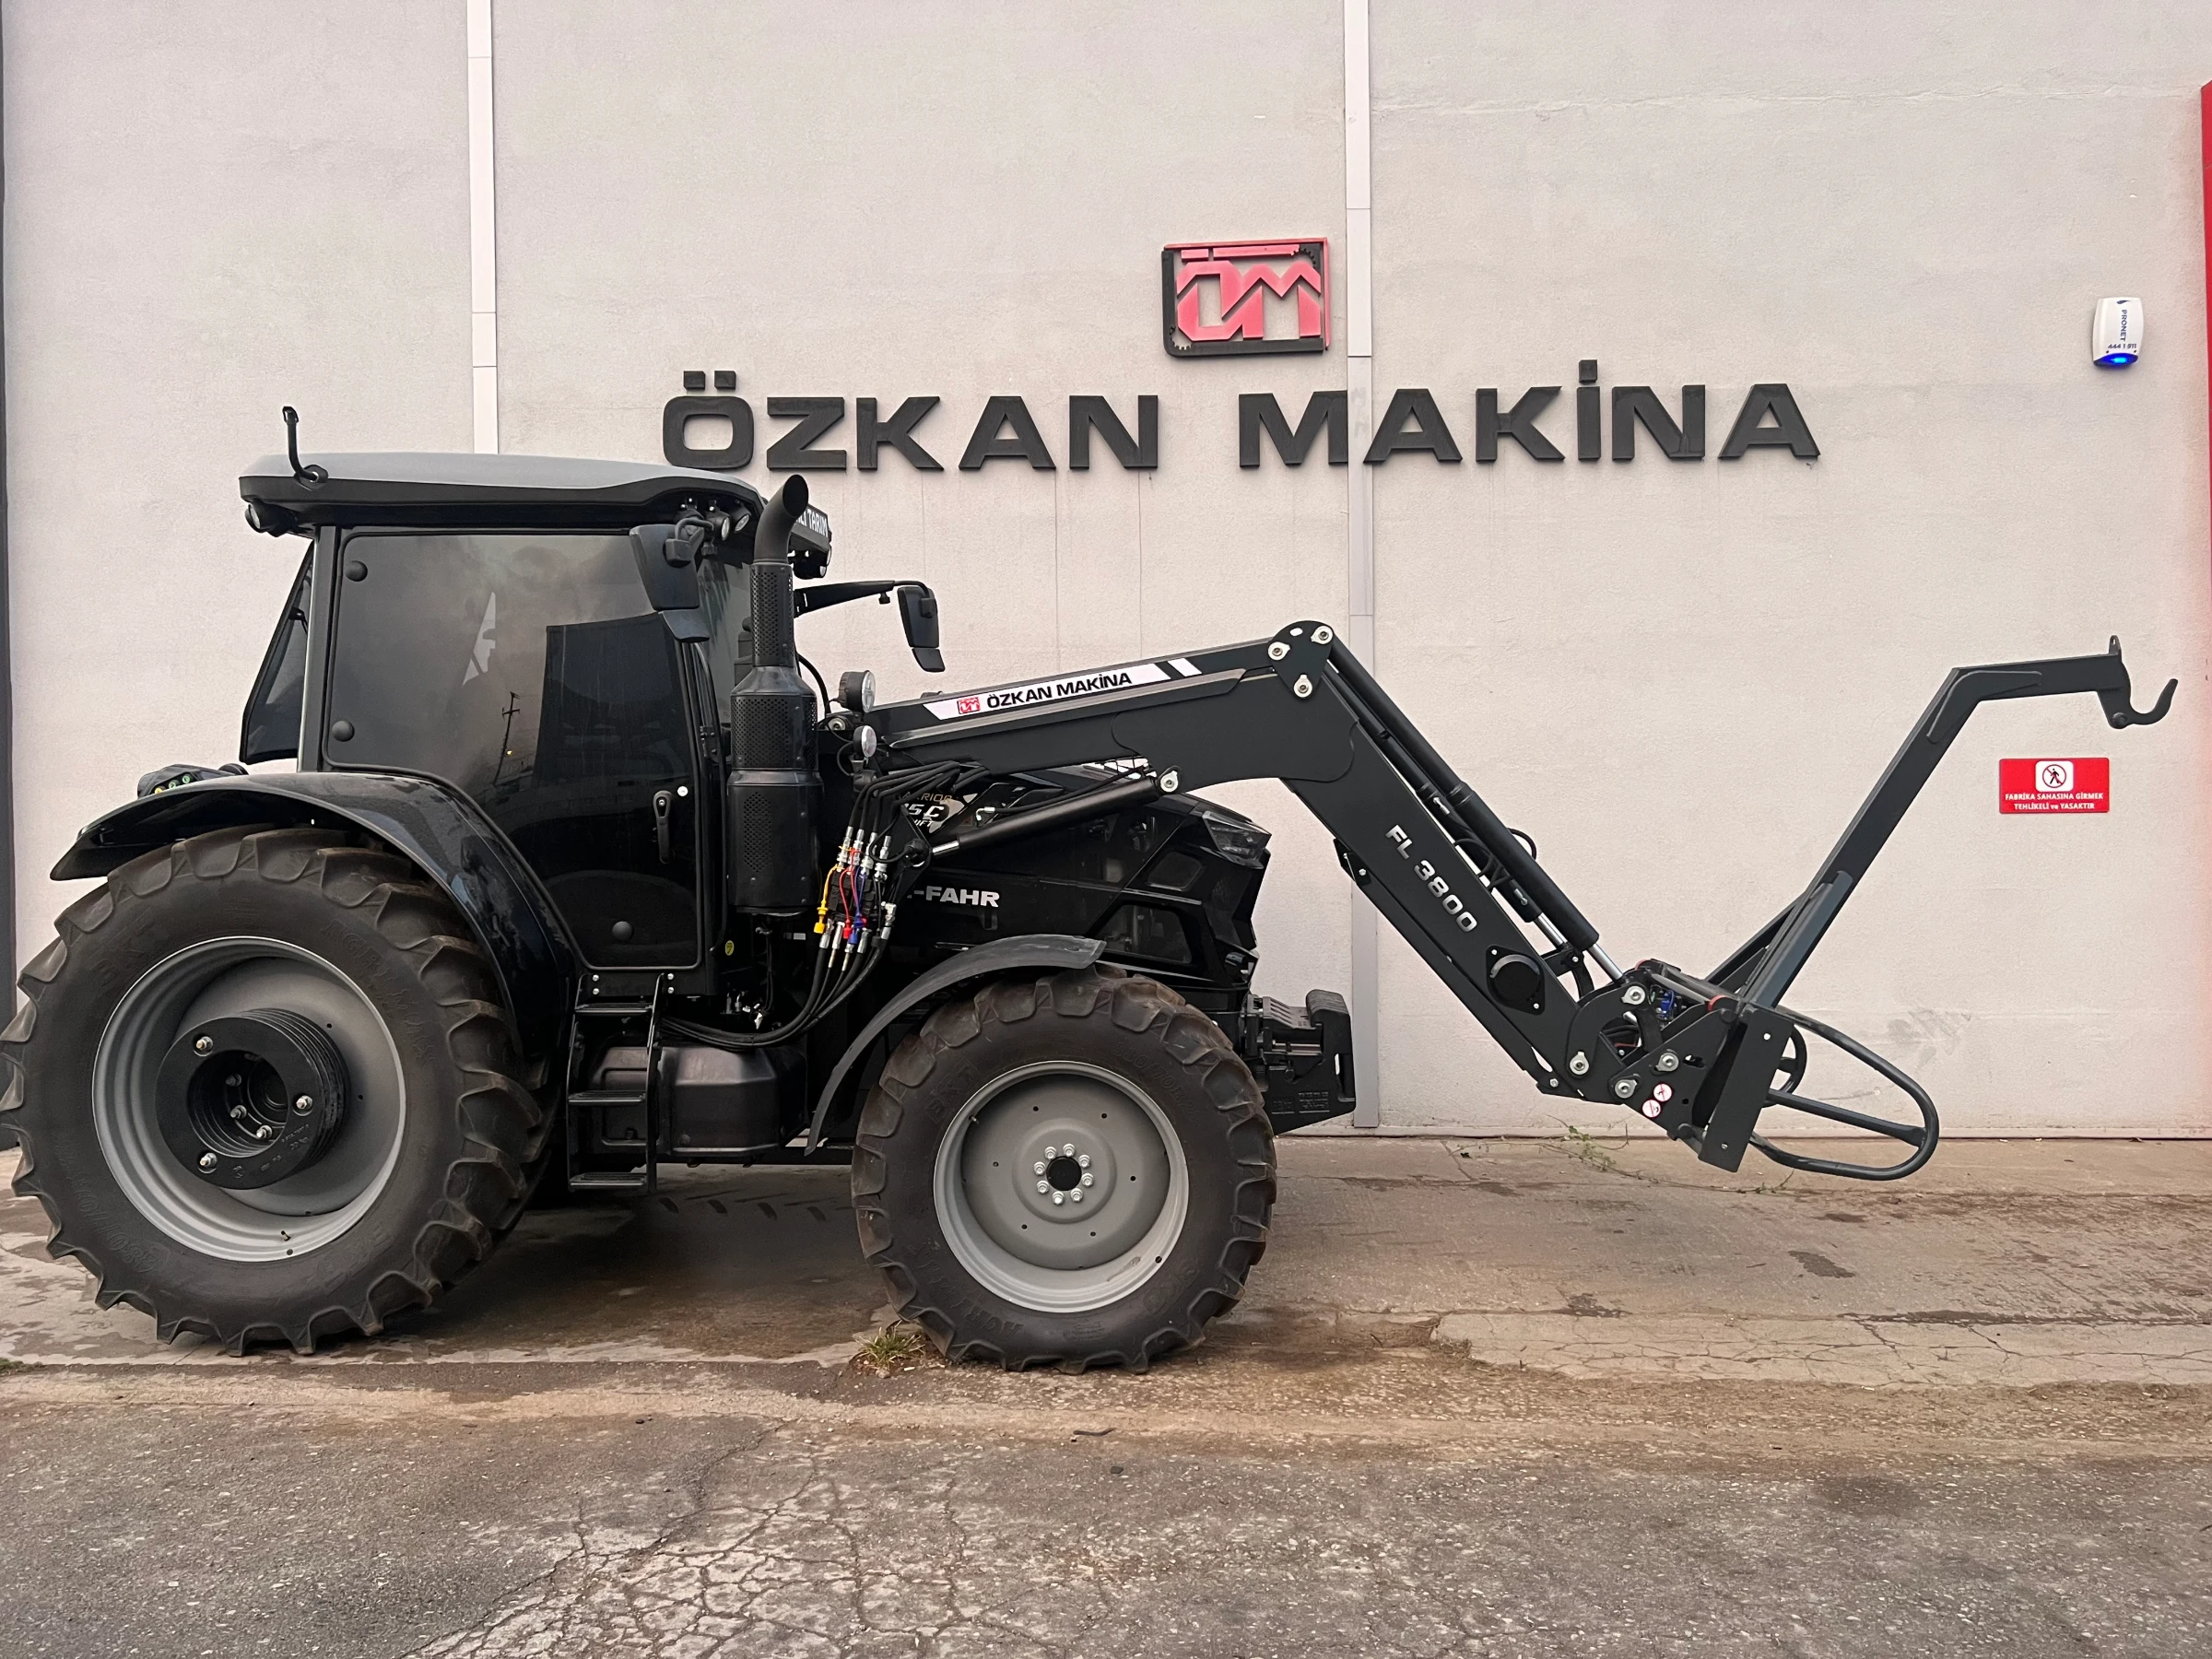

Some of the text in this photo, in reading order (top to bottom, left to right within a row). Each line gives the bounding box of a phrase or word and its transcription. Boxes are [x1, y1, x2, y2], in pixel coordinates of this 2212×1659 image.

[2120, 309, 2128, 341] PRONET
[662, 359, 1821, 471] ÖZKAN MAKİNA
[806, 508, 829, 538] TARIM
[986, 686, 1053, 709] ÖZKAN
[1055, 672, 1133, 697] MAKİNA
[2005, 791, 2104, 801] FABRİKA SAHASINA GİRMEK
[2013, 801, 2050, 810] TEHLİKELİ
[2059, 802, 2095, 810] YASAKTIR
[1385, 824, 1477, 933] FL 3800
